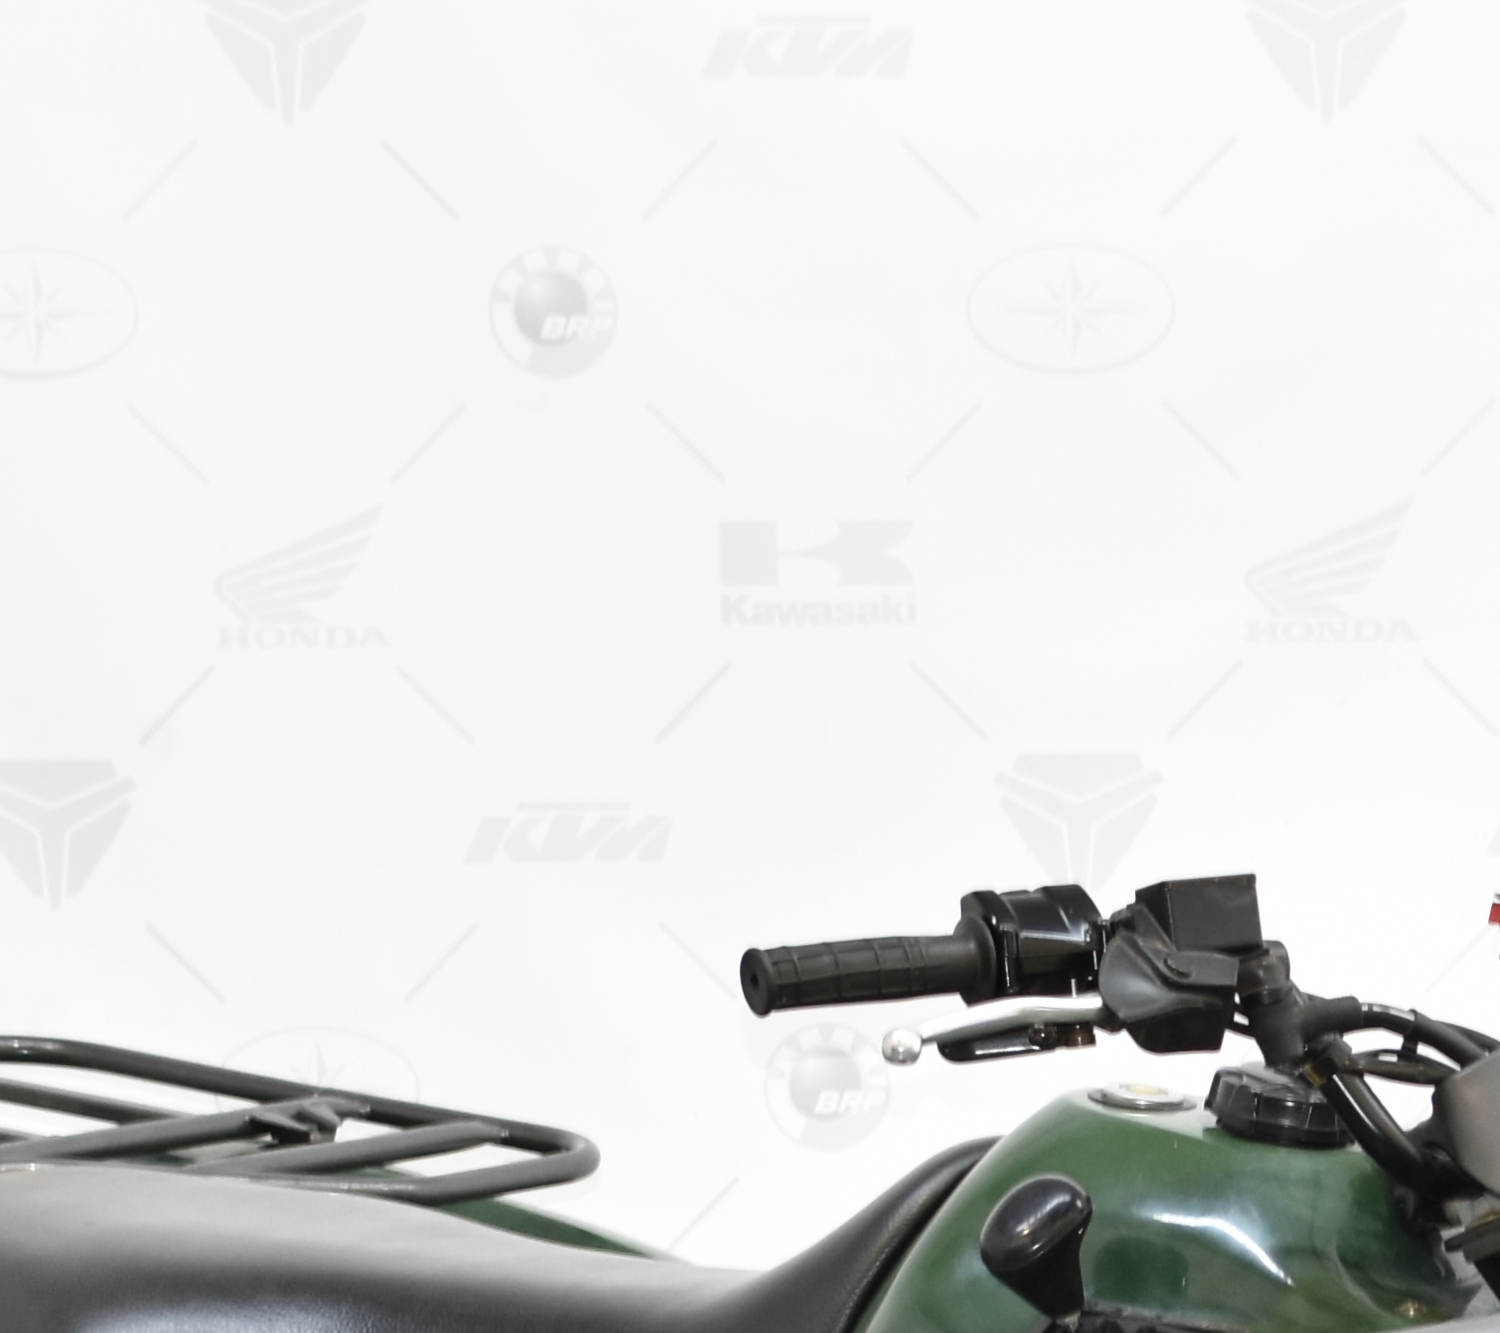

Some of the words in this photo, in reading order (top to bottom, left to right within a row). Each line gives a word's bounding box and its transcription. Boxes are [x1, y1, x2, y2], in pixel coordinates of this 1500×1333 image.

[700, 14, 914, 80] KTM
[540, 315, 615, 339] BRP
[720, 593, 917, 627] Kawasaki
[214, 626, 394, 649] HONDA
[1245, 618, 1421, 643] HONDA
[463, 801, 673, 865] KTM
[814, 1089, 887, 1113] BRP
